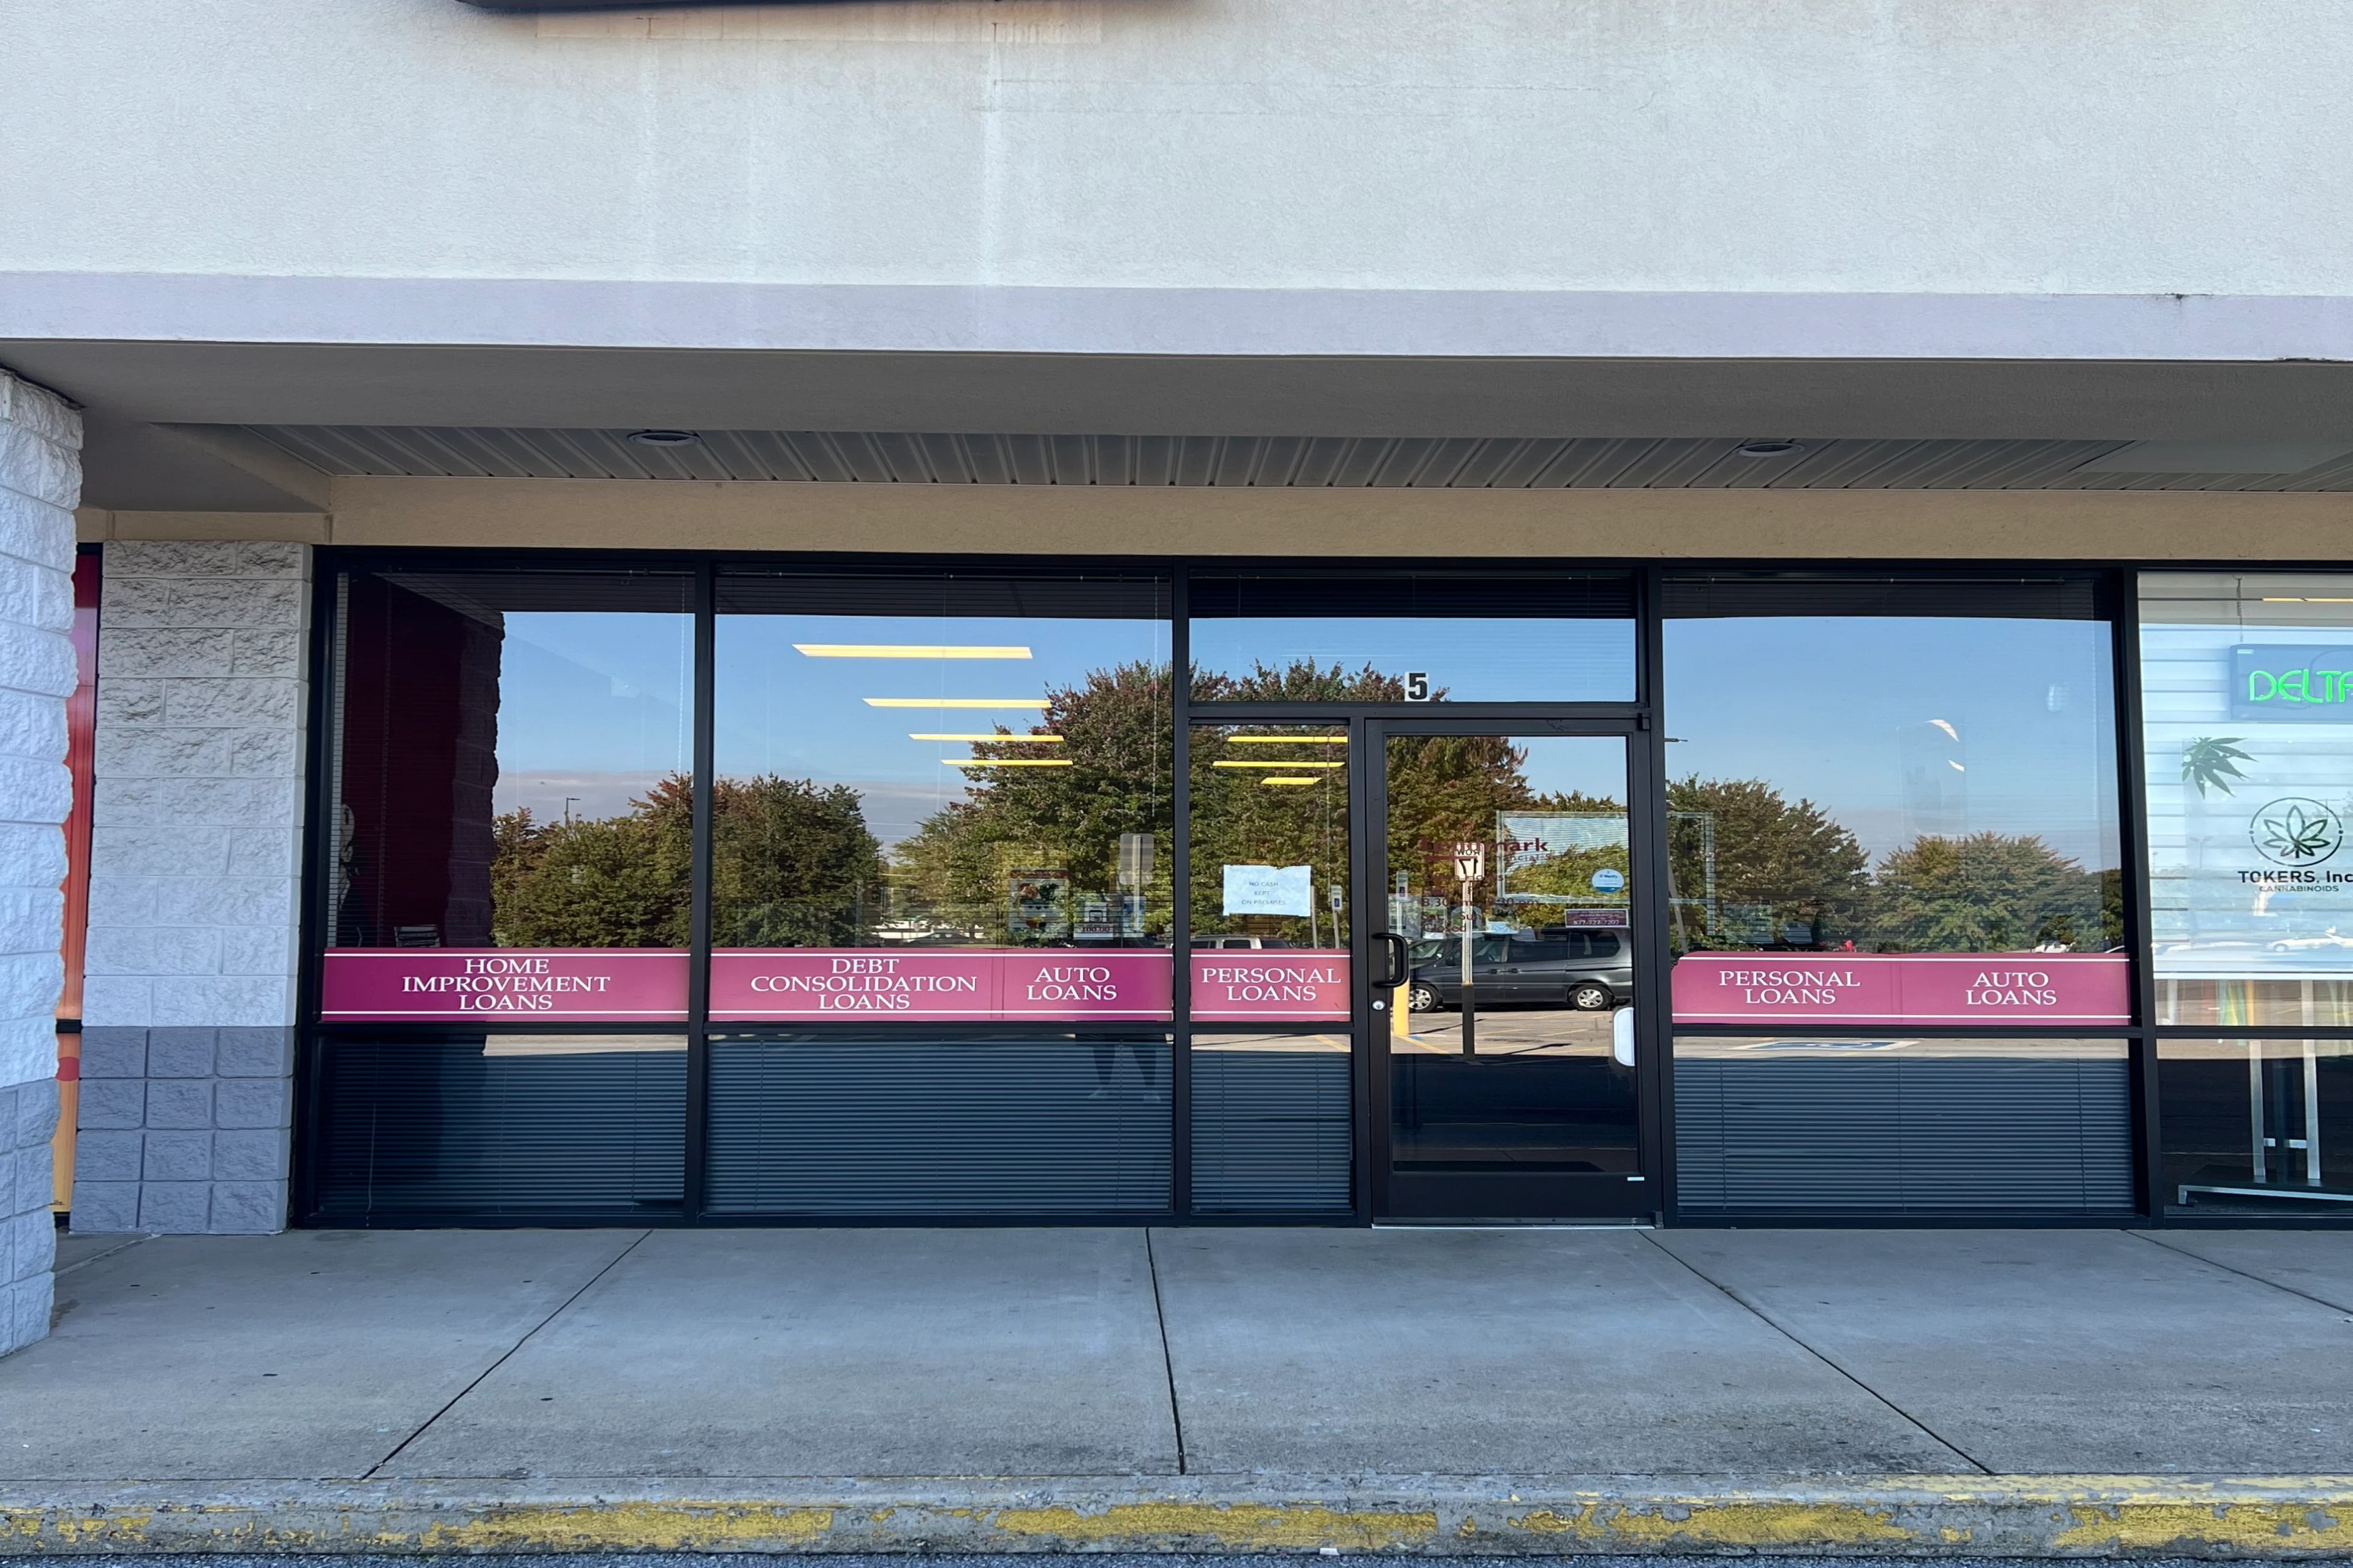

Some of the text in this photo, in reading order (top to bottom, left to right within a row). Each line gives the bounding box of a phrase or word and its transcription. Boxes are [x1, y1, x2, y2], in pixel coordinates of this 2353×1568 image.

[1408, 672, 1428, 700] 5
[466, 959, 549, 974] HOME
[832, 959, 900, 973] DEBT
[1034, 968, 1110, 982] AUTO
[1202, 968, 1341, 983] PERSONAL
[1719, 971, 1861, 987] PERSONAL
[1972, 972, 2049, 987] AUTO
[403, 977, 611, 992] IMPROVEMENT
[751, 977, 977, 991] CONSOLIDATION
[1027, 985, 1117, 1000] LOANS
[1227, 986, 1317, 1001] LOANS
[1745, 989, 1836, 1004] LOANS
[1966, 990, 2057, 1005] LOANS
[460, 994, 553, 1009] LOANS
[819, 994, 911, 1009] LOANS
